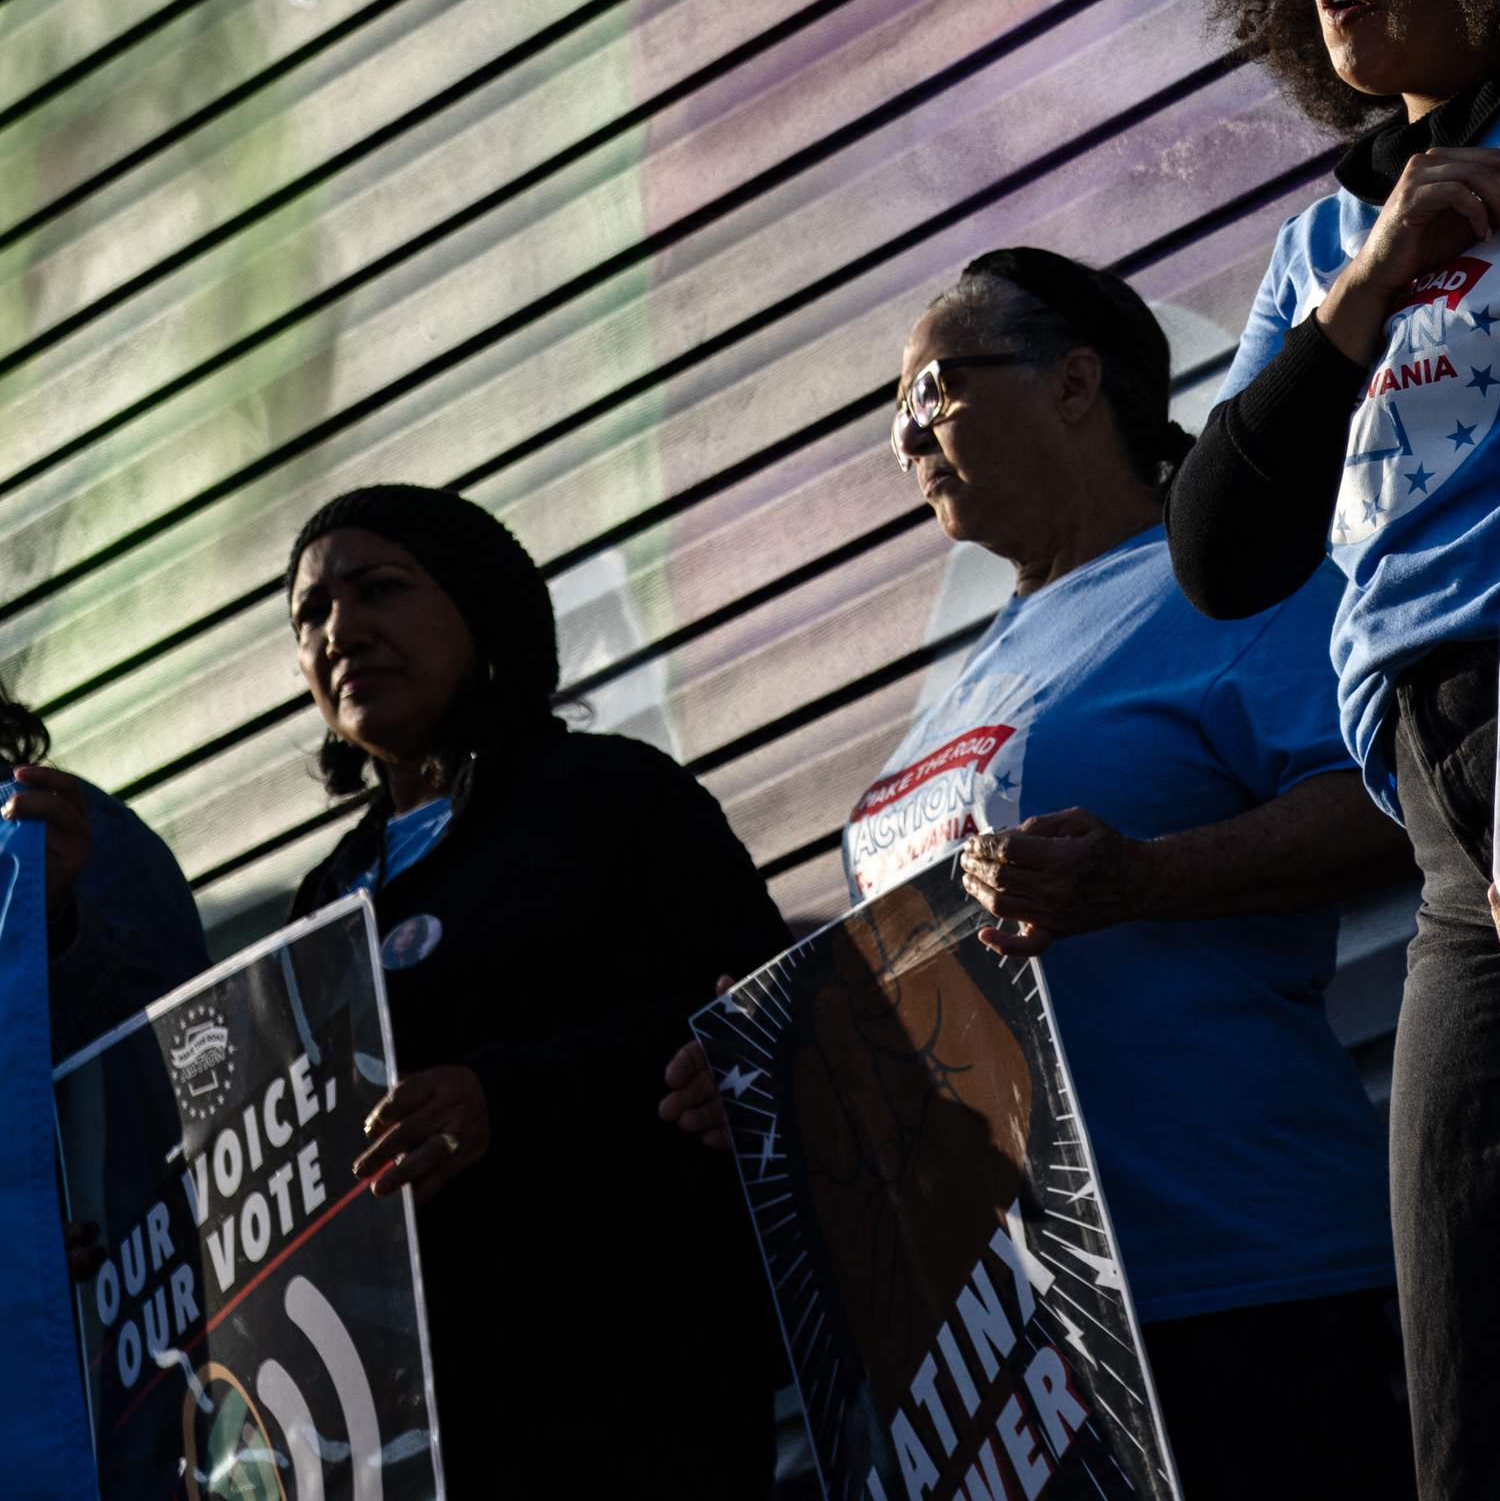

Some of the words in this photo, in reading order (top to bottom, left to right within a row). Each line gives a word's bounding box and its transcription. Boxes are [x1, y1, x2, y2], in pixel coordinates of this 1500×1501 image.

[852, 758, 979, 864] ACTION
[96, 1200, 176, 1327] OUR
[181, 1053, 338, 1228] VOICE,
[117, 1262, 200, 1388] OUR
[206, 1141, 327, 1293] VOTE
